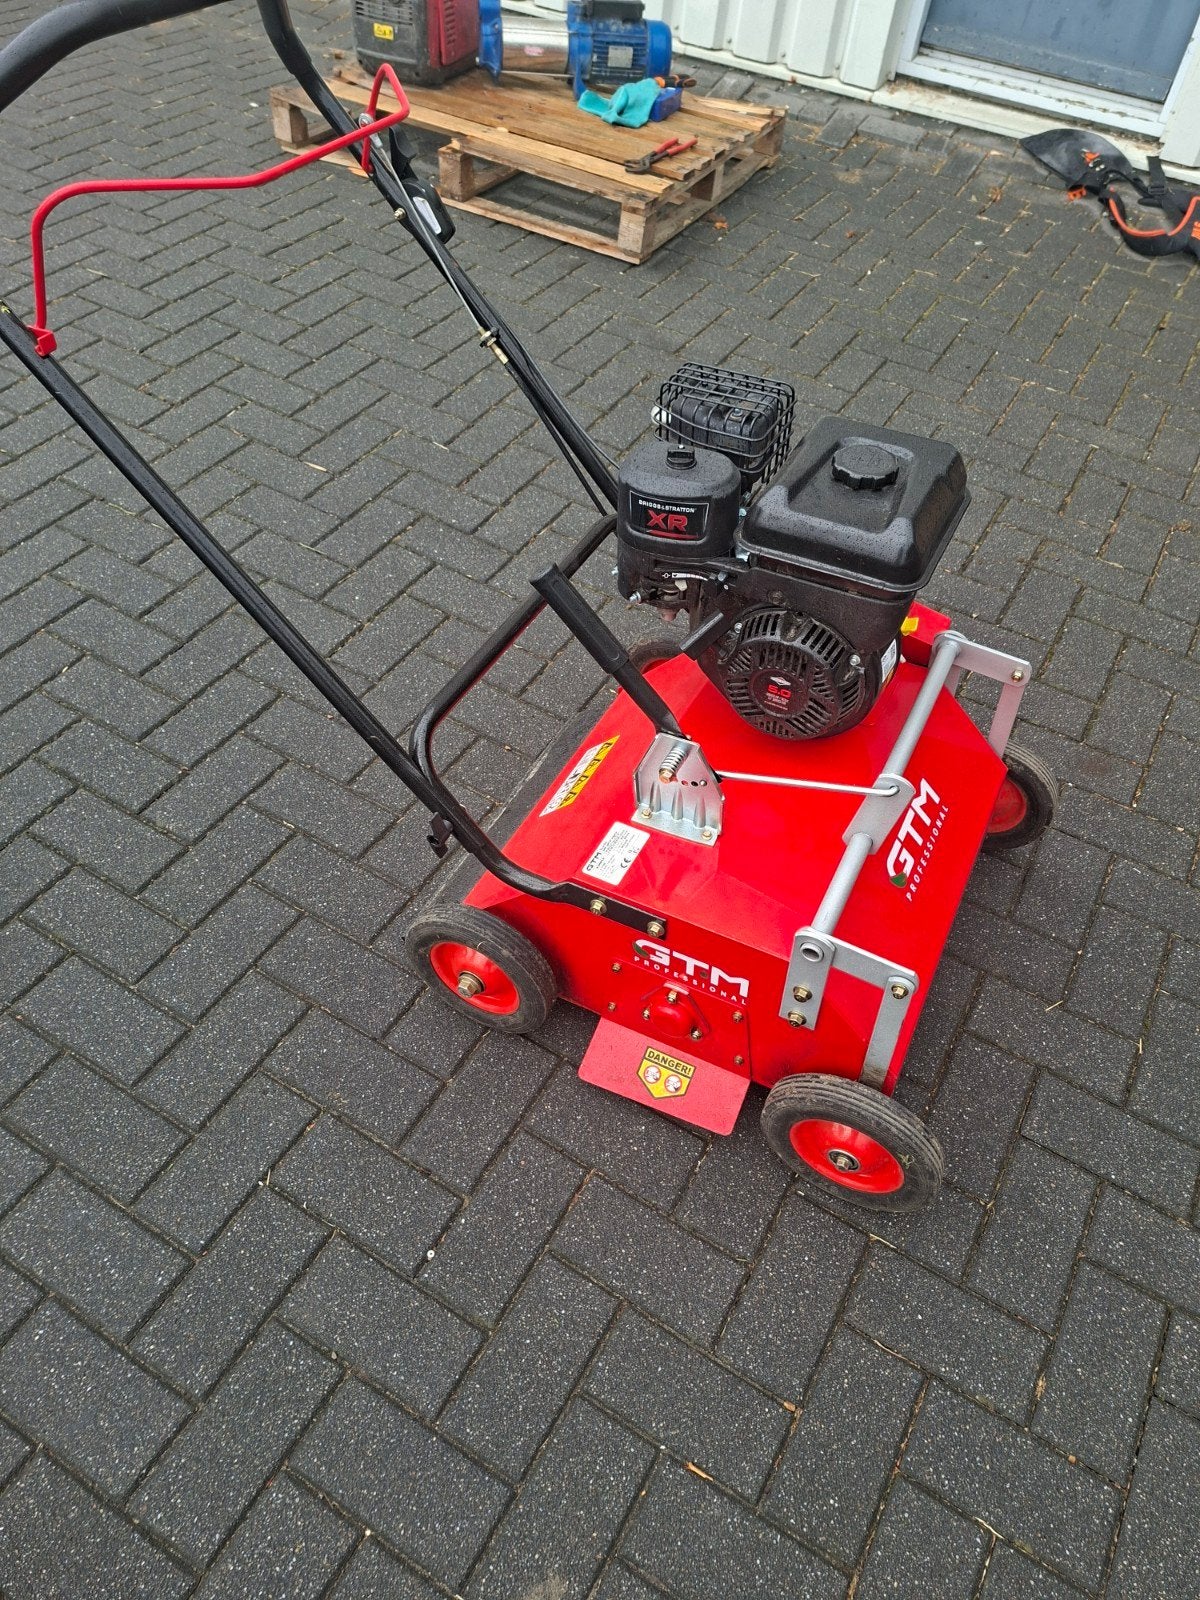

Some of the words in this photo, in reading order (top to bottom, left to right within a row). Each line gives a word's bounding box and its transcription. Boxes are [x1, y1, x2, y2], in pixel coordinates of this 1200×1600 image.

[647, 509, 688, 532] XR
[768, 684, 791, 698] 5.0
[887, 777, 940, 888] GTM
[586, 851, 602, 871] GTM
[906, 804, 949, 902] PROFESSIONAL
[632, 939, 750, 998] GTM
[634, 956, 746, 1006] PROFESSIONAL
[647, 1050, 692, 1076] DANGER!
